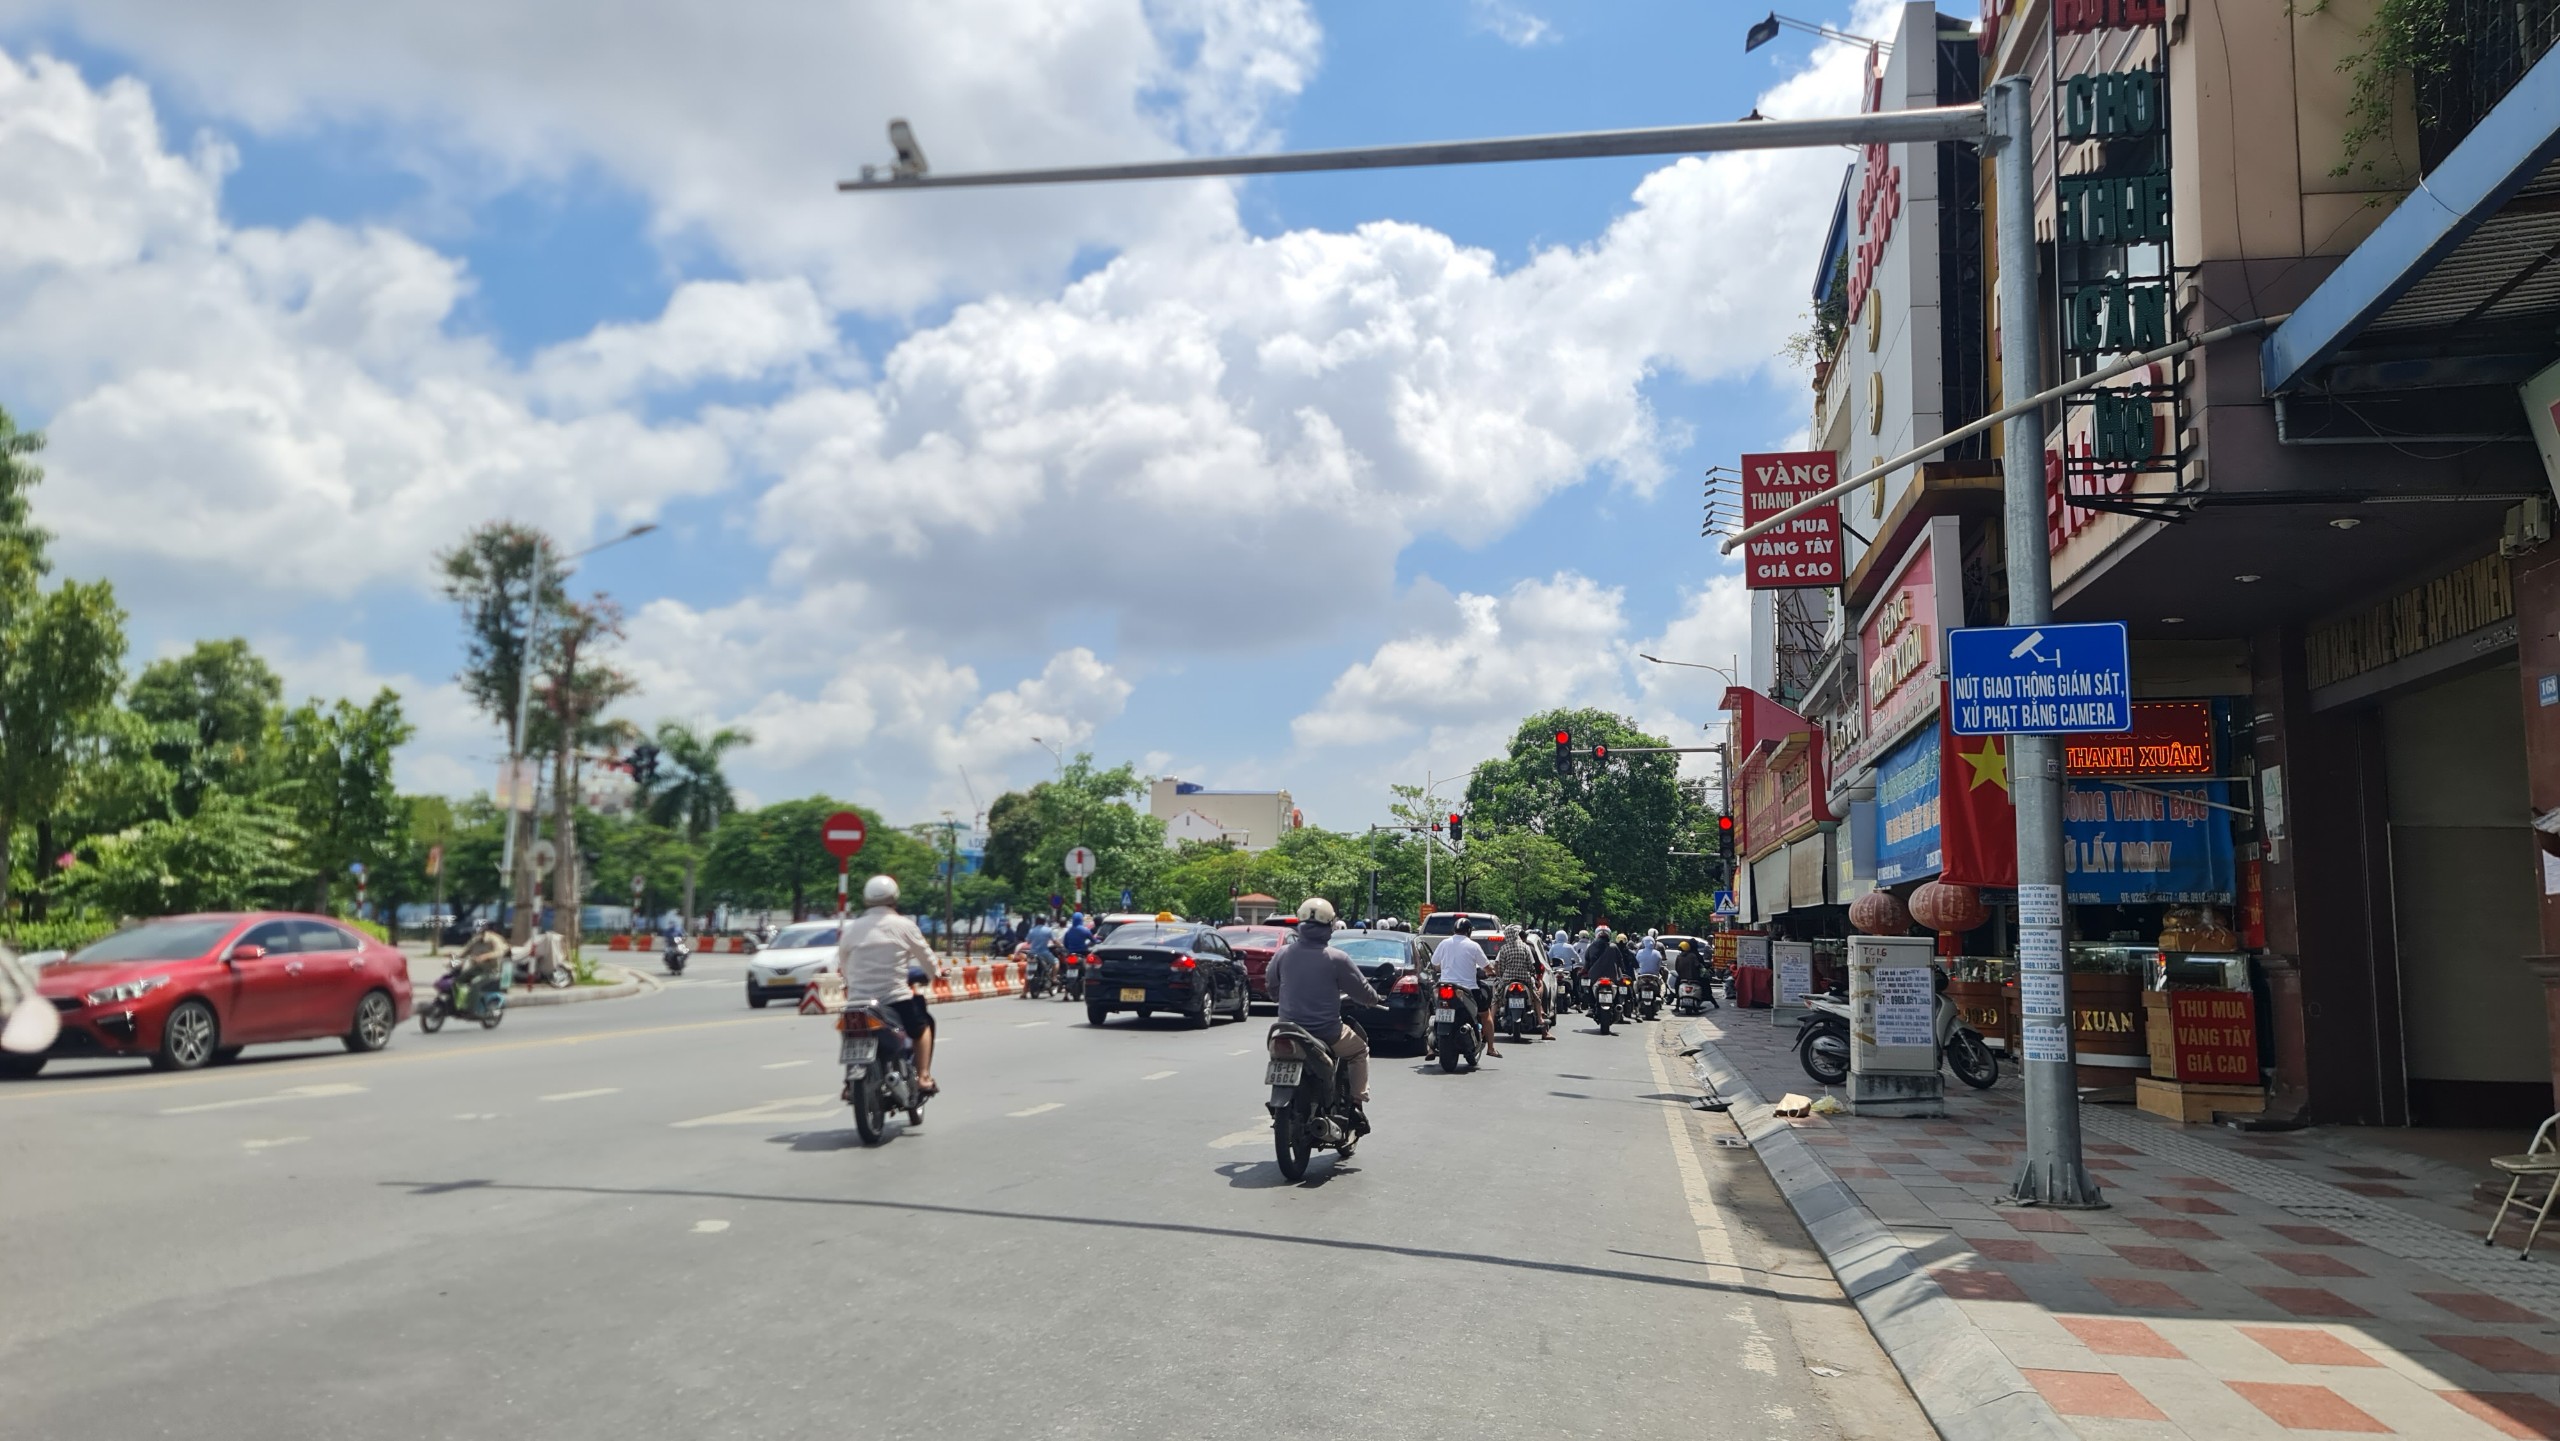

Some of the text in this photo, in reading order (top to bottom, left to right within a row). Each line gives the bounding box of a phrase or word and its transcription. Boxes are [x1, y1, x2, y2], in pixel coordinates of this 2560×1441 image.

[2067, 69, 2155, 142] CHO
[2059, 161, 2169, 247] THUÊ
[2073, 271, 2167, 351] CĂN
[2092, 382, 2155, 471] HỘ
[1755, 460, 1830, 486] VÀNG
[1750, 491, 1794, 510] THANH
[1792, 518, 1829, 534] MUA
[1751, 537, 1834, 556] VÀNG TÂY
[1758, 560, 1833, 578] GIÁ CAO
[2393, 587, 2425, 660] SIDE
[1955, 673, 1980, 699] NÚT
[1983, 676, 2012, 698] GIAO
[2014, 672, 2056, 697] THÔNG
[2057, 671, 2092, 696] GIÁM
[2093, 669, 2125, 698] SÁT,
[2541, 679, 2557, 696] 163
[1962, 699, 1980, 729] XỬ
[1984, 705, 2018, 731] PHẠT
[2022, 698, 2057, 727] BẰNG
[2059, 702, 2116, 727] CAMERA
[2066, 746, 2134, 768] THANH
[2139, 741, 2203, 767] XUÂN
[2063, 785, 2107, 822] ÓNG
[2081, 832, 2117, 873] LẤY
[2121, 841, 2173, 873] NGAY
[2178, 1000, 2246, 1019] THU MUA
[2178, 1024, 2220, 1047] VÀNG
[2223, 1025, 2251, 1047] TÂY
[2187, 1051, 2247, 1073] GIÁ CAO
